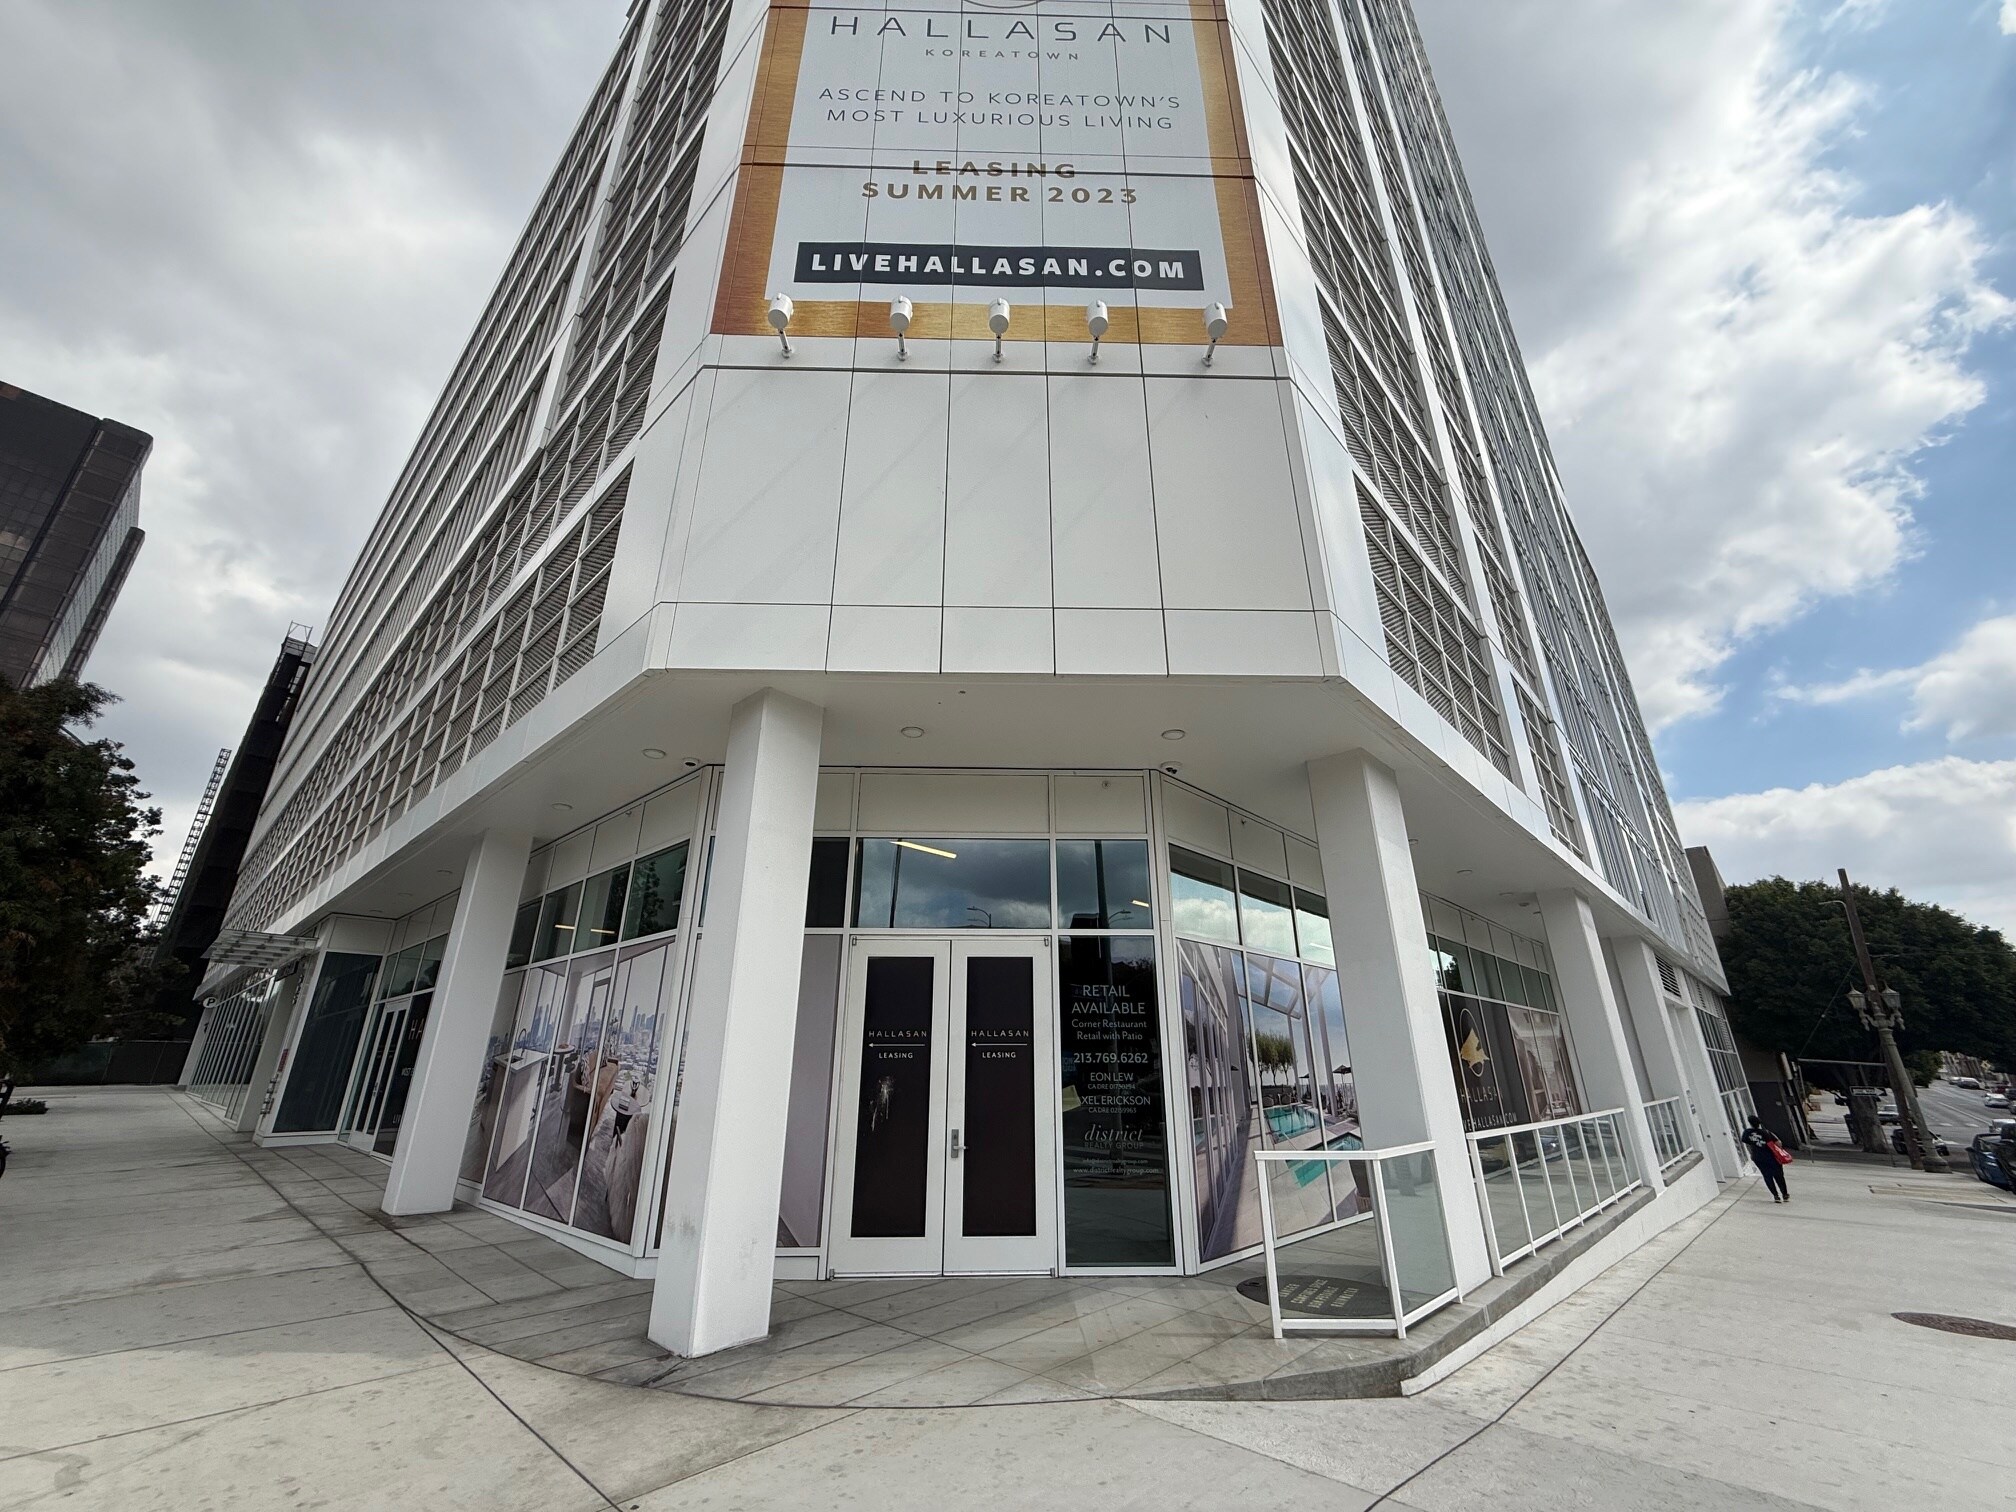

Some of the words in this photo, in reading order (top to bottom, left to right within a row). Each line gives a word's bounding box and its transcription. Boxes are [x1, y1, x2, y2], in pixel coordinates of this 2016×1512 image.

[830, 15, 1171, 44] HALLASAN
[925, 48, 1080, 61] KOREATOWN
[818, 87, 926, 102] ASCEND
[939, 90, 975, 104] TO
[988, 92, 1181, 109] KOREATOWN'S
[826, 108, 904, 123] MOST
[917, 111, 1070, 127] LUXURIOUS
[1084, 116, 1173, 130] LIVING
[912, 159, 1077, 179] LEASING
[861, 181, 1031, 203] SUMMER
[1047, 186, 1138, 204] 2023
[811, 253, 1184, 279] LIVEHALLASAN.COM
[1082, 984, 1130, 997] RETAIL
[1071, 1002, 1146, 1014] AVAILABLE
[1071, 1019, 1100, 1028] Corner
[1102, 1019, 1147, 1028] Restaurant
[868, 1030, 928, 1038] HALLASAN
[1076, 1031, 1101, 1040] Retail
[1102, 1031, 1120, 1040] with
[1122, 1031, 1143, 1040] Patio
[982, 1051, 1017, 1059] LEASING
[1073, 1052, 1148, 1063] 213.769.6262
[1090, 1072, 1111, 1082] EON
[1113, 1072, 1134, 1082] LEW
[1101, 1095, 1151, 1105] ERICKSON
[1084, 1123, 1143, 1141] district
